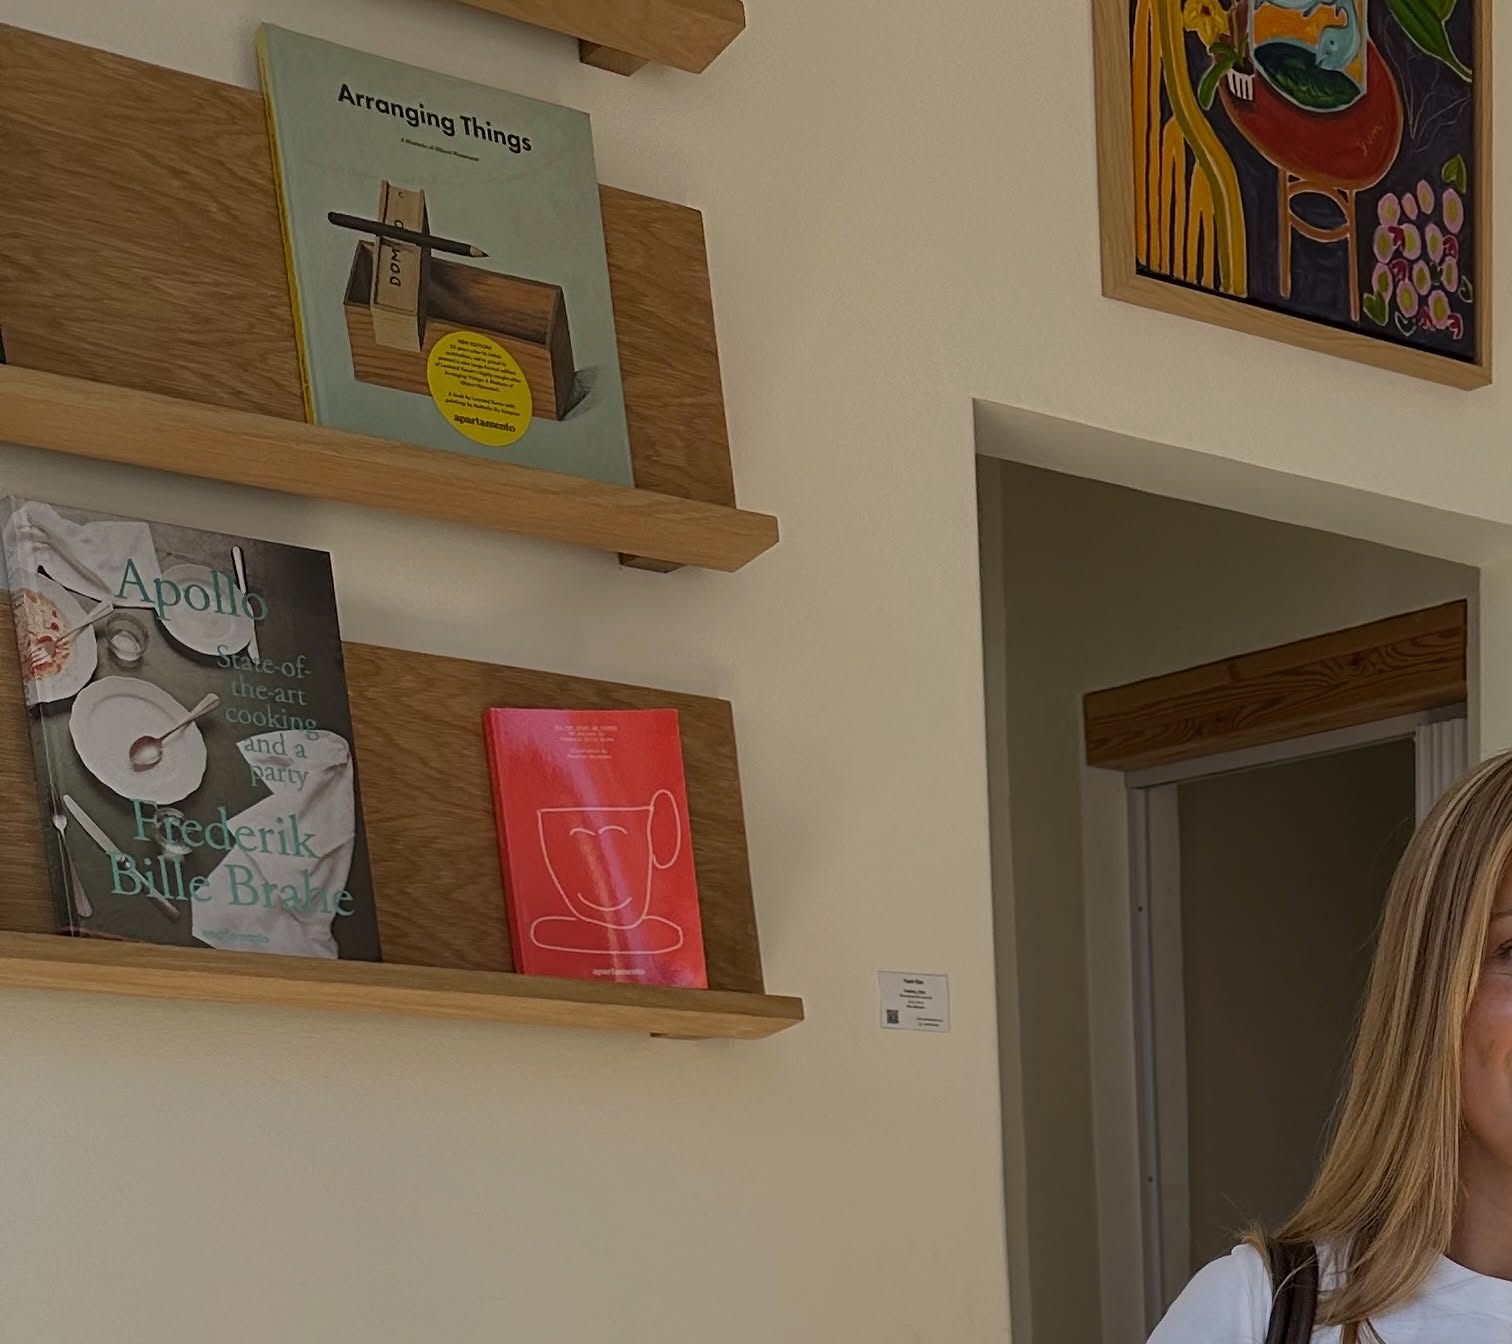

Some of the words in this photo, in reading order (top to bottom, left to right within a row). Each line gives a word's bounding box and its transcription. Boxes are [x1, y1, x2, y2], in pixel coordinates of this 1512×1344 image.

[338, 83, 455, 136] Arranging
[460, 115, 532, 153] Things
[389, 219, 405, 287] DOMO
[454, 414, 516, 432] apartamento
[115, 558, 268, 621] Apollo
[216, 644, 311, 679] State-of-
[232, 675, 307, 706] the-art
[225, 706, 319, 741] cooking
[244, 733, 287, 756] and
[296, 743, 307, 759] a
[251, 765, 309, 790] party
[129, 799, 320, 859] Frederik
[106, 852, 212, 901] Bille
[224, 863, 355, 916] Brahe
